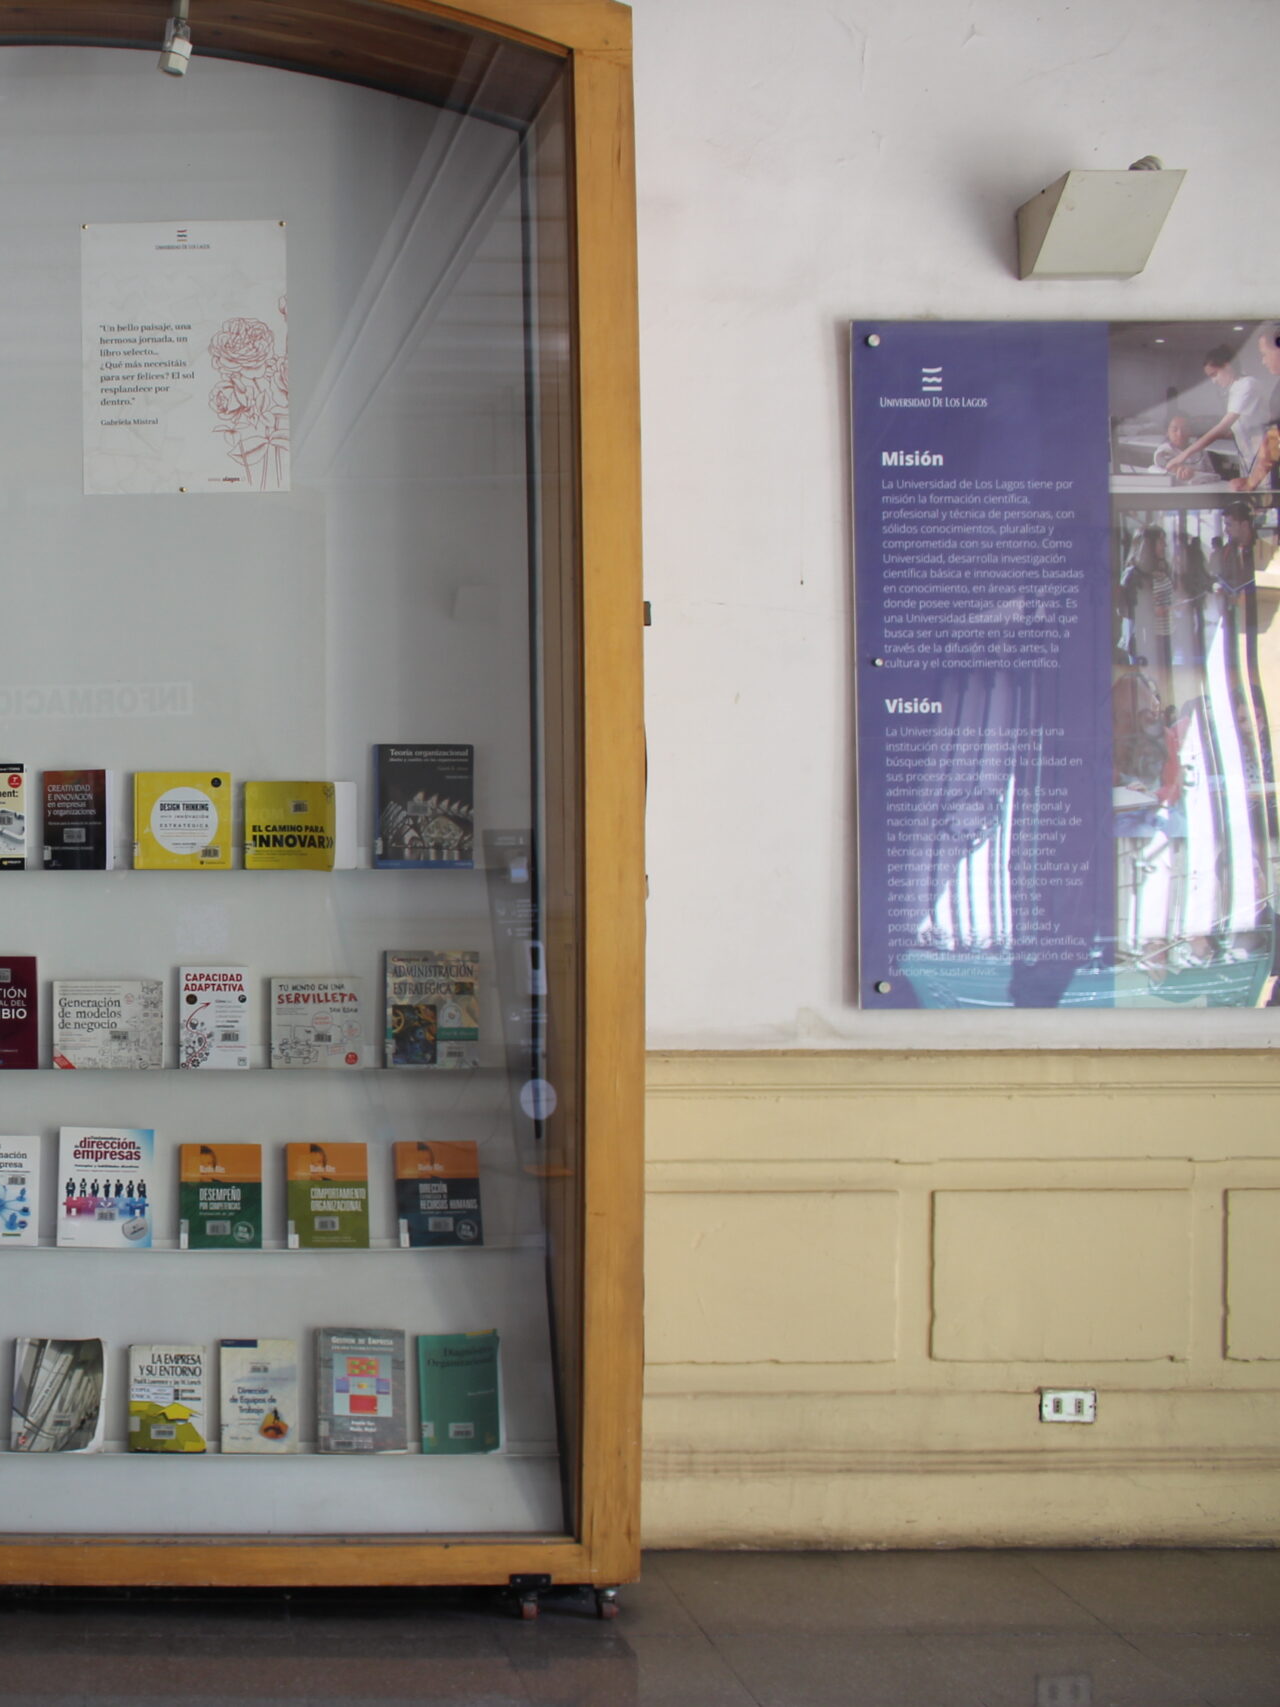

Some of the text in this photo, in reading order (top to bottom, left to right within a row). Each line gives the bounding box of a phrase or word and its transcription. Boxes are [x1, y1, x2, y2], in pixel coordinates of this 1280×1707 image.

[117, 323, 139, 331] bello
[141, 323, 173, 332] paisaje,
[138, 335, 174, 345] jornada,
[100, 349, 119, 357] libro
[124, 360, 141, 368] más
[144, 359, 186, 368] necesitáis
[100, 374, 120, 382] para
[137, 372, 169, 381] felices?
[182, 371, 194, 379] sol
[101, 385, 152, 395] resplandece
[882, 451, 944, 466] Misión
[882, 479, 1074, 492] La Universidad de Los Lagos tiene por
[882, 494, 1030, 505] misión la formación científica,
[882, 509, 1074, 521] profesional y técnica de personas, con
[885, 698, 942, 713] Visión
[390, 749, 468, 758] Teoría organizacional
[160, 803, 209, 811] DESIGN THINKING
[252, 825, 324, 833] EL CAMINO PARA
[252, 834, 326, 849] INNOVAR
[392, 962, 474, 978] ADMINISTRACIÓN
[185, 973, 243, 982] CAPACIDAD
[184, 983, 244, 992] ADAPTATIVA
[59, 997, 121, 1008] Generación
[277, 992, 358, 1004] SERVILLETA
[58, 1009, 122, 1018] de modelos
[58, 1019, 117, 1032] de negocio
[79, 1137, 136, 1150] dirección
[73, 1149, 141, 1162] empresas
[199, 1186, 241, 1202] DESEMPEÑO
[151, 1354, 201, 1365] LA EMPRESA
[139, 1365, 202, 1377] Y SU ENTORNO
[237, 1386, 269, 1395] Dirección
